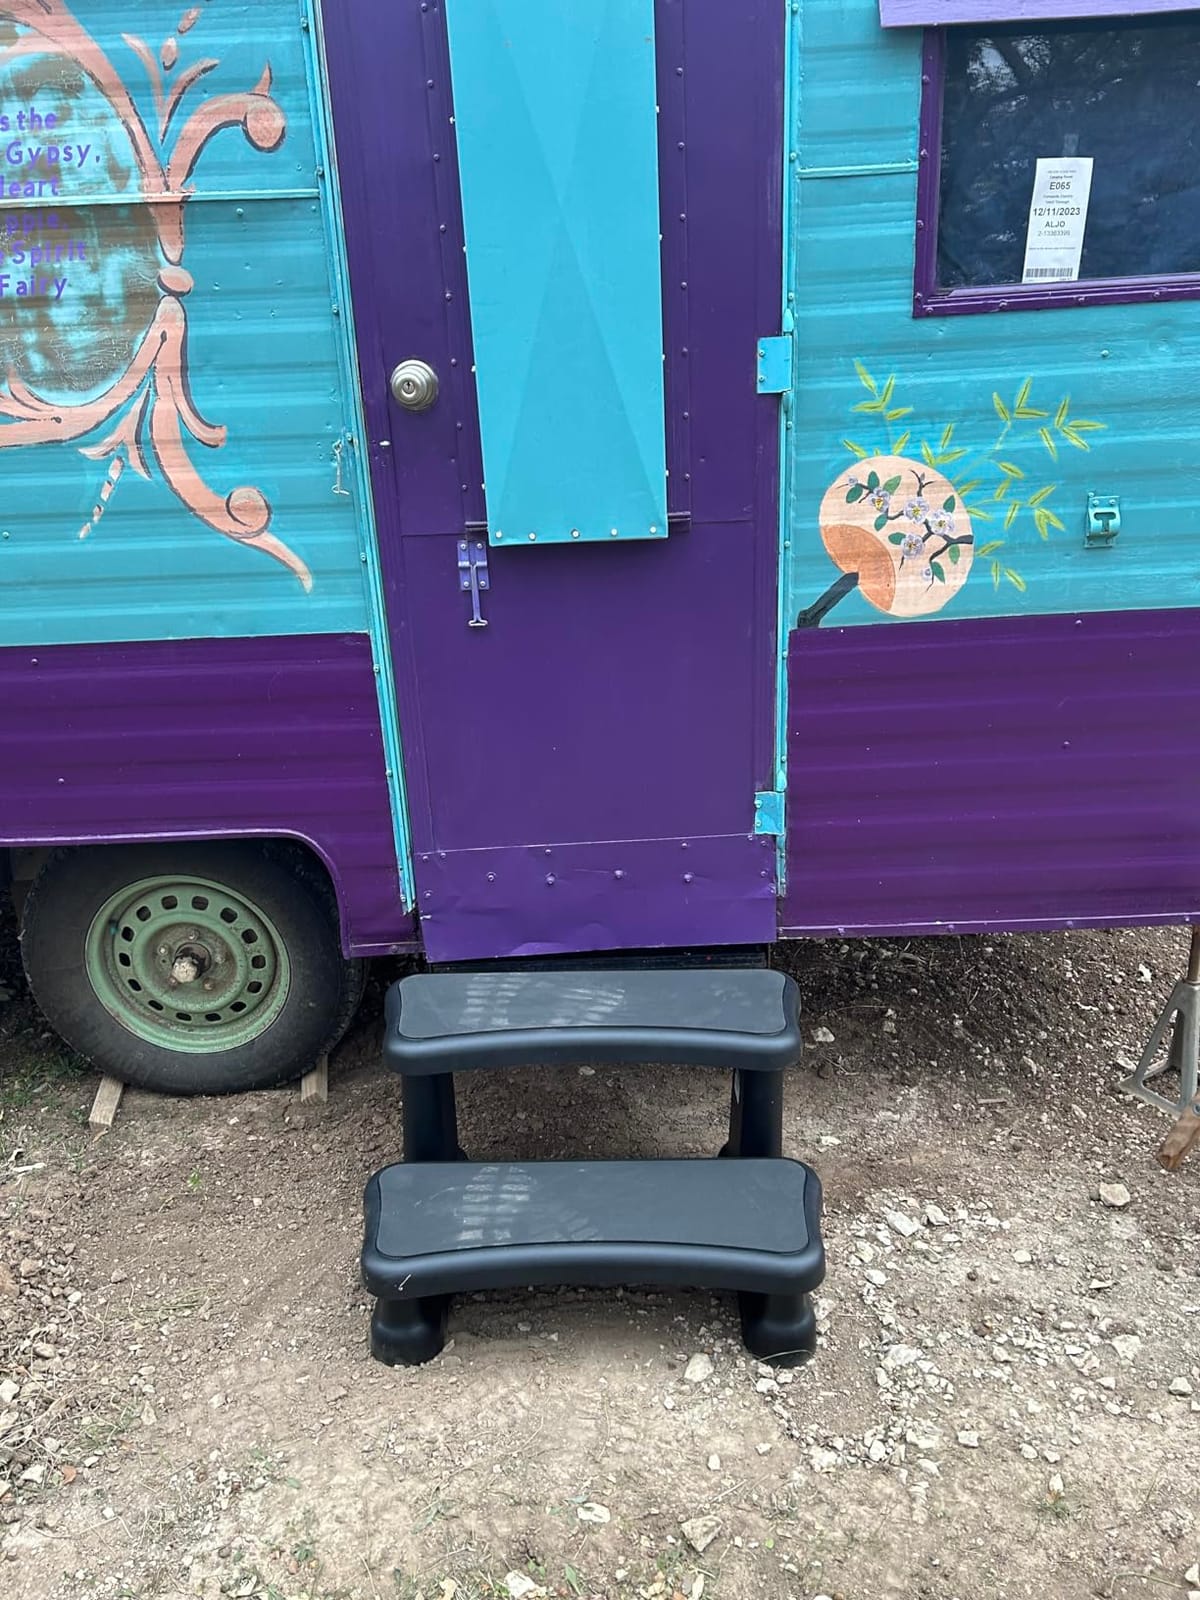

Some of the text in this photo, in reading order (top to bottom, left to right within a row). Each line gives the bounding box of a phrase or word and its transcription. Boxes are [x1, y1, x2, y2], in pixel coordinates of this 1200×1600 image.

[17, 106, 57, 131] the
[6, 141, 101, 171] Gypsy,
[0, 175, 59, 199] eart
[1049, 181, 1072, 191] E065
[1032, 207, 1081, 217] 12/11/2023
[1045, 220, 1066, 228] ALJO
[11, 240, 87, 268] Spirit
[0, 273, 68, 300] Fairy
